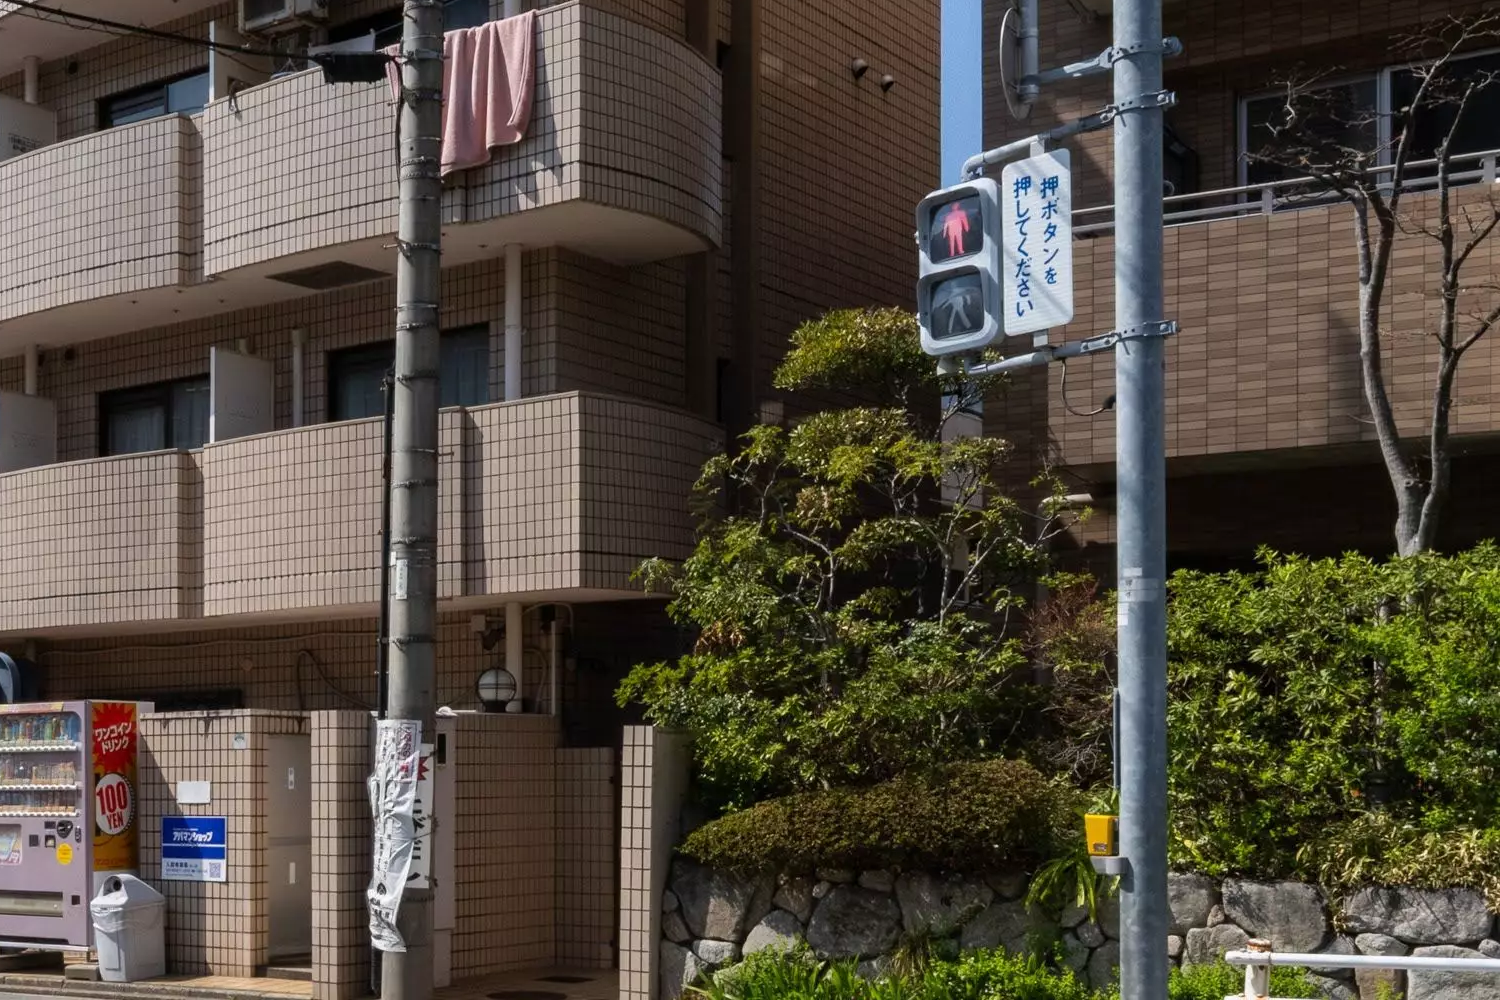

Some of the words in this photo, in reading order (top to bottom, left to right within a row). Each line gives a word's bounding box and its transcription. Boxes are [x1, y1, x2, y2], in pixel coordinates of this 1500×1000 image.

[1040, 175, 1059, 285] 押ボタンを
[1013, 175, 1033, 317] 押してください
[95, 722, 132, 742] ワンコイン
[102, 736, 130, 754] ドリンク
[96, 781, 128, 816] 100
[106, 814, 124, 831] YEN
[172, 831, 214, 843] アパマンショップ
